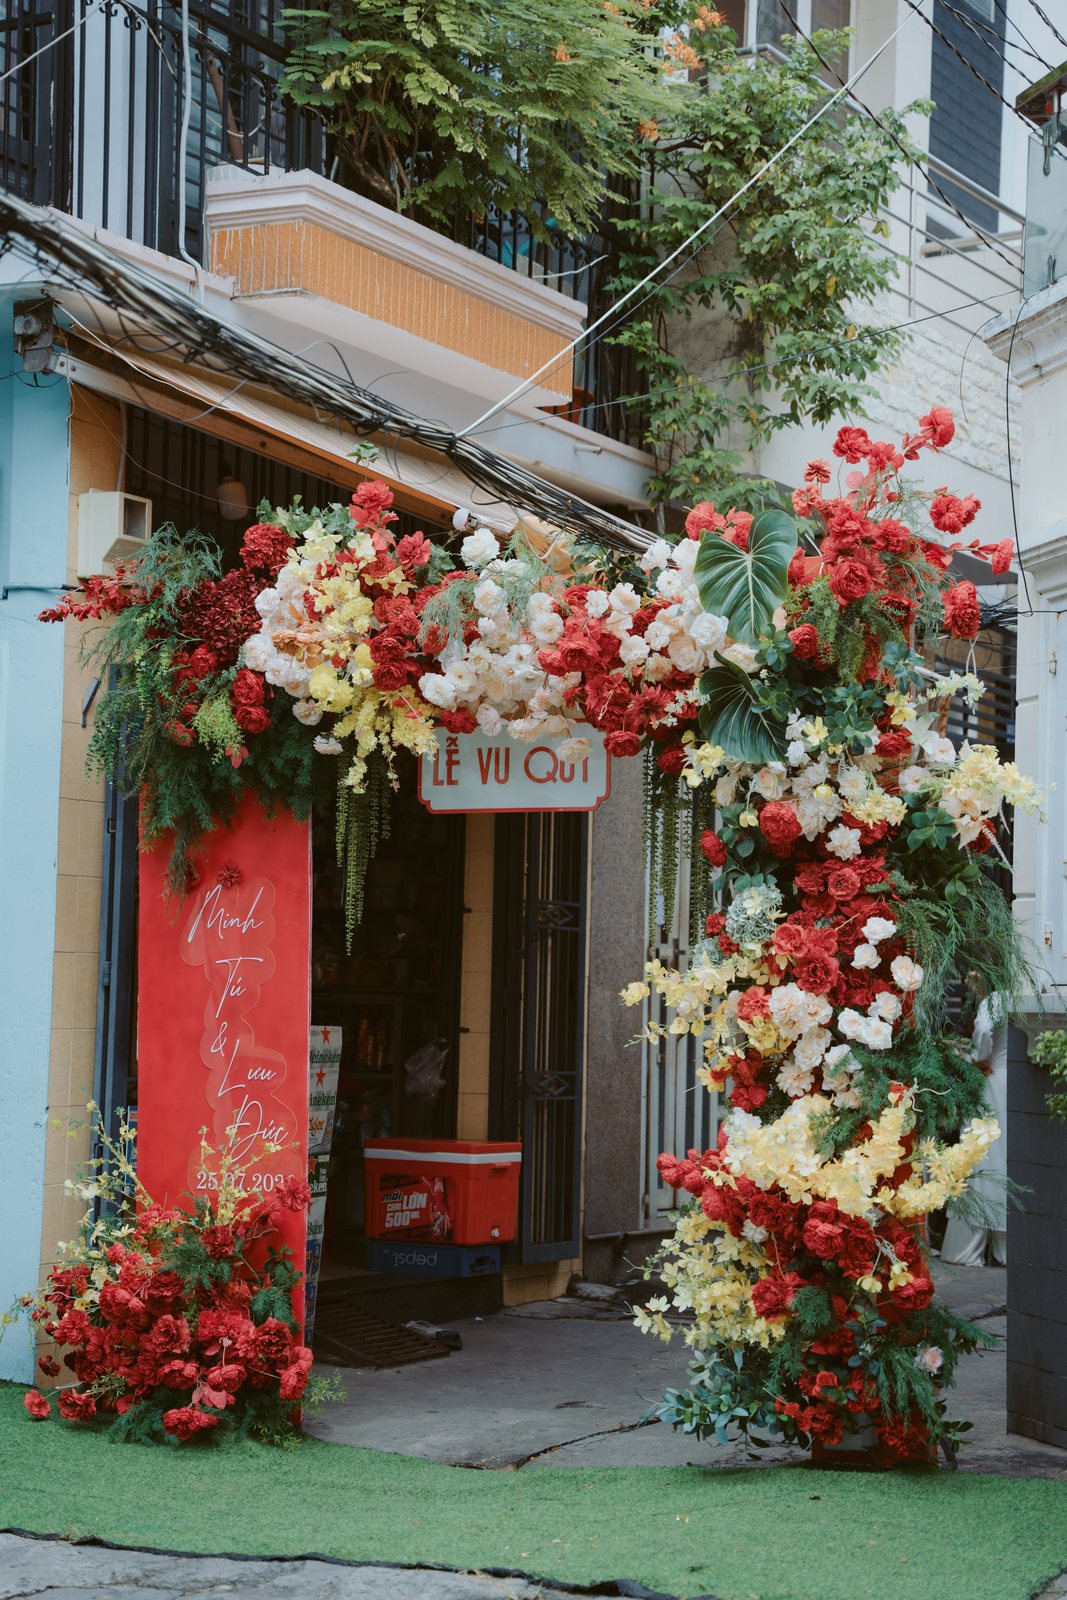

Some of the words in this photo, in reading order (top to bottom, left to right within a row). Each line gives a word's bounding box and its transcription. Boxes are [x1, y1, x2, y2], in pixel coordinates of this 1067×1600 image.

[433, 737, 460, 786] LỄ
[477, 747, 510, 785] VU
[187, 884, 264, 943] Minh
[216, 956, 264, 1019] Tú
[210, 1021, 228, 1056] &
[309, 1050, 341, 1064] eineken
[309, 1092, 336, 1106] ineken
[394, 1251, 438, 1268] pepsi
